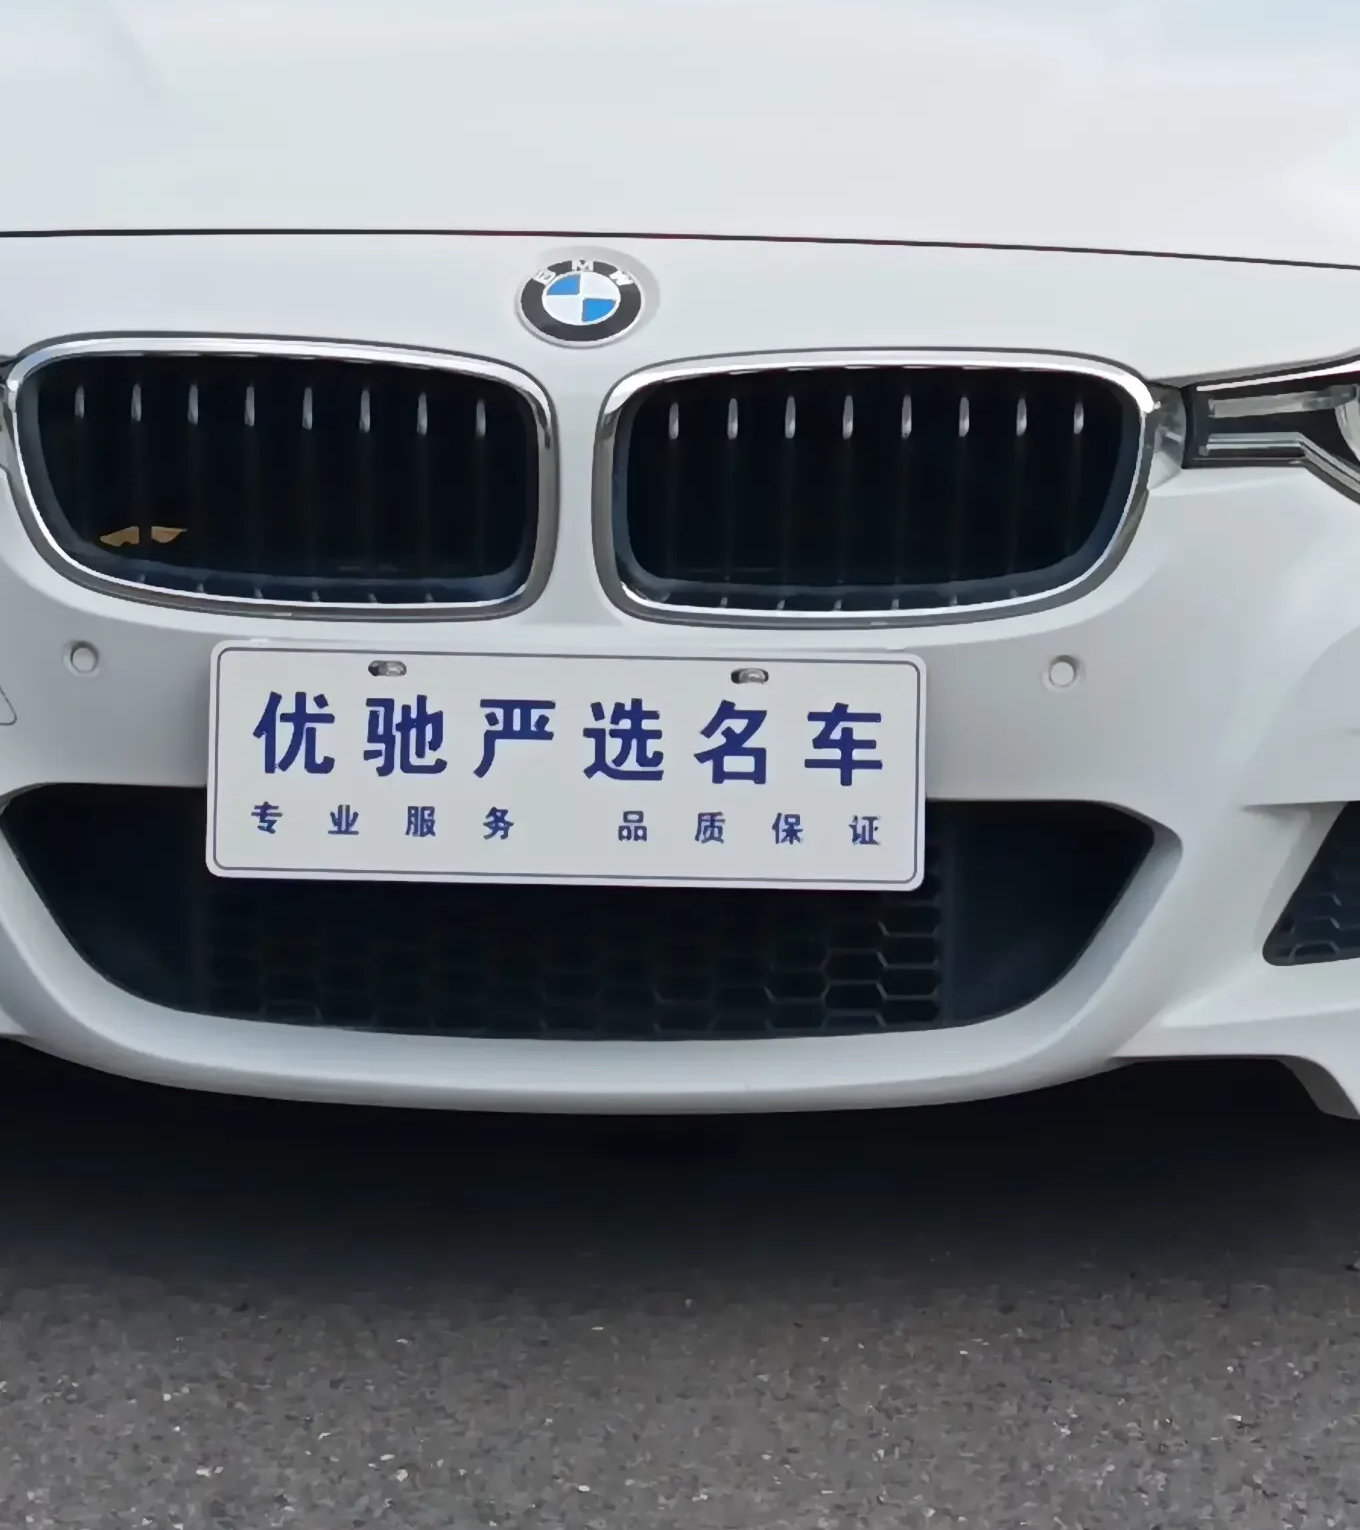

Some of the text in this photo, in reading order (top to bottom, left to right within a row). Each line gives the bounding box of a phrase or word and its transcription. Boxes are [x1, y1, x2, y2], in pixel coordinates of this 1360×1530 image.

[532, 259, 635, 286] BMW
[253, 691, 884, 787] 优驰严选名车
[251, 801, 881, 847] 专业服务 品质保证
